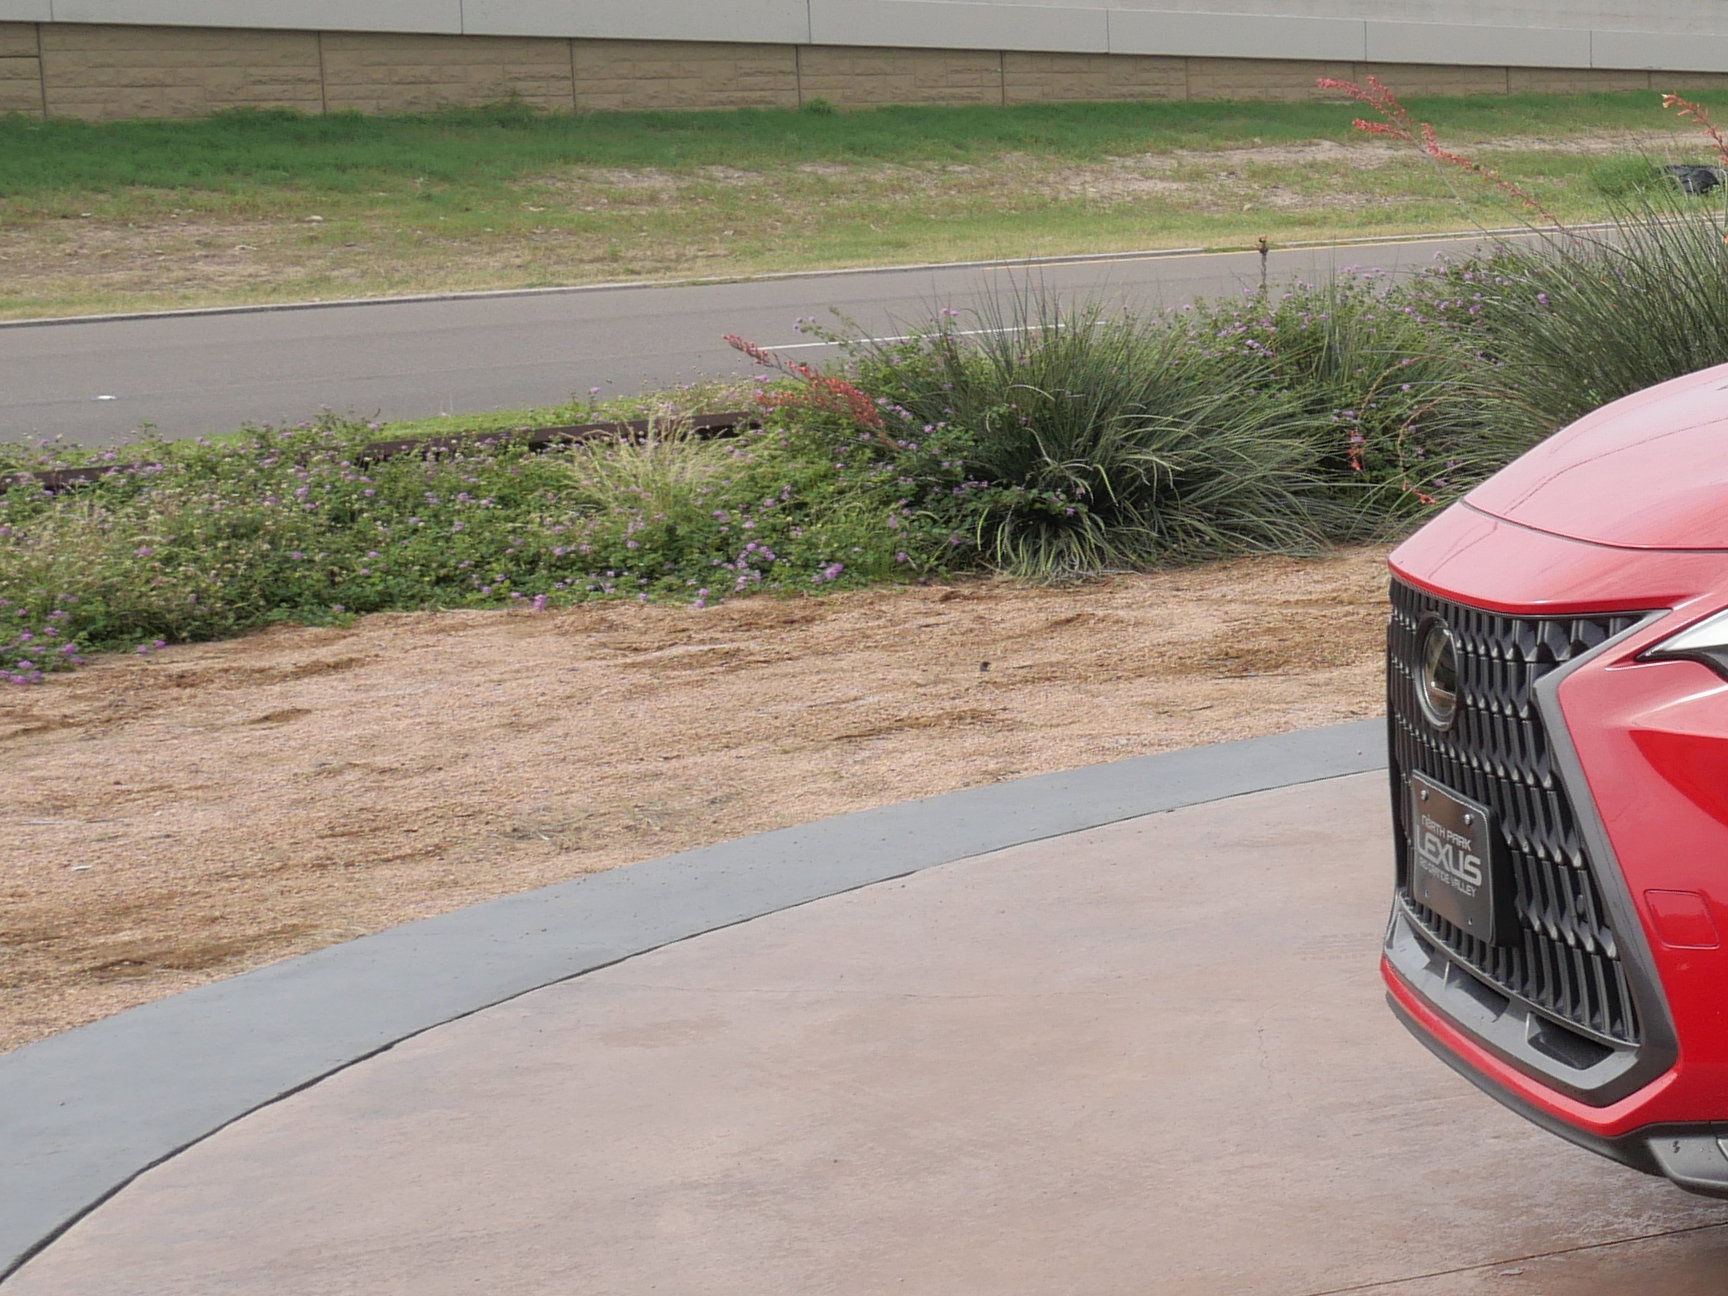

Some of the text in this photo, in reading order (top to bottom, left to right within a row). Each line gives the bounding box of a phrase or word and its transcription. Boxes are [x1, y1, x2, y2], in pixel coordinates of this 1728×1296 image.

[1446, 829, 1471, 852] PARK
[1415, 823, 1482, 886] LEXUS
[1451, 874, 1477, 897] VALLEY
